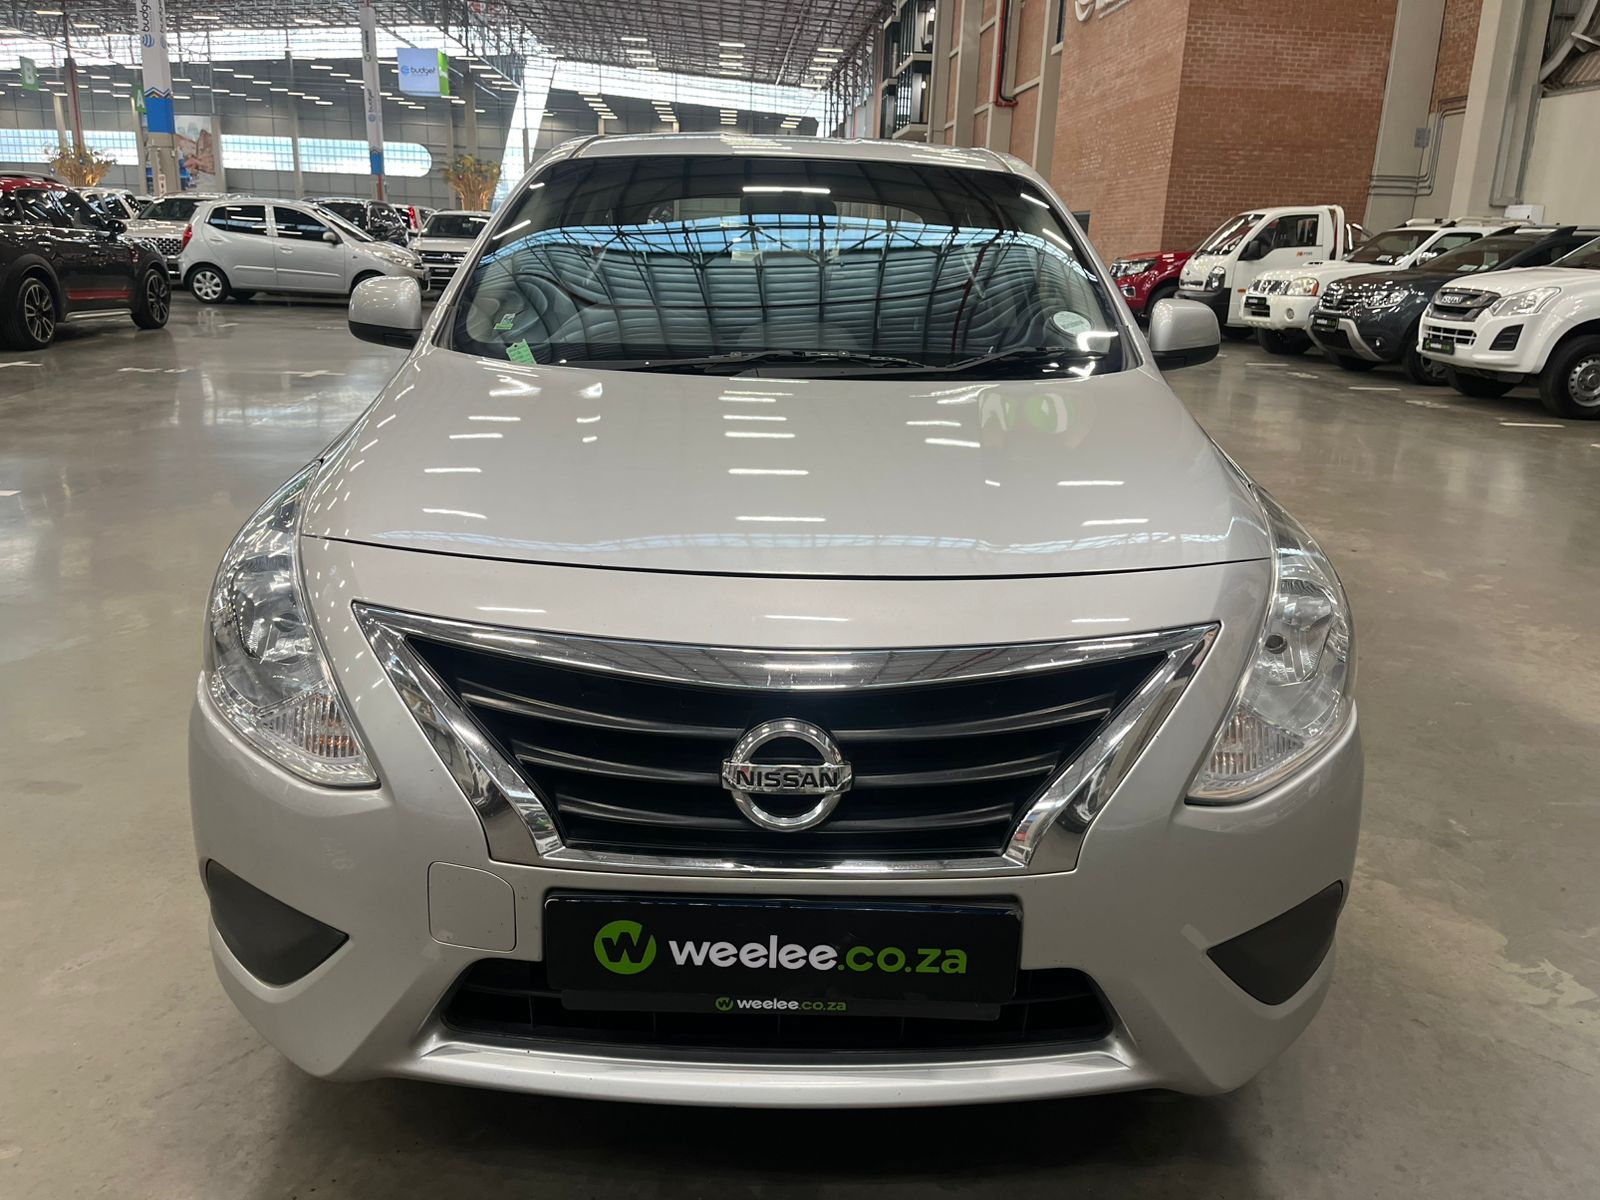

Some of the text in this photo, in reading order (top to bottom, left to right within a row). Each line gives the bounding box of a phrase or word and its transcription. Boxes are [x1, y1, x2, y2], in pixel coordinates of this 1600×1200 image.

[23, 62, 35, 85] B
[410, 67, 435, 77] budget
[136, 89, 145, 108] A
[736, 769, 837, 788] NISSAN
[668, 934, 968, 975] weelee.co.za
[737, 998, 847, 1011] weelee.co.za
